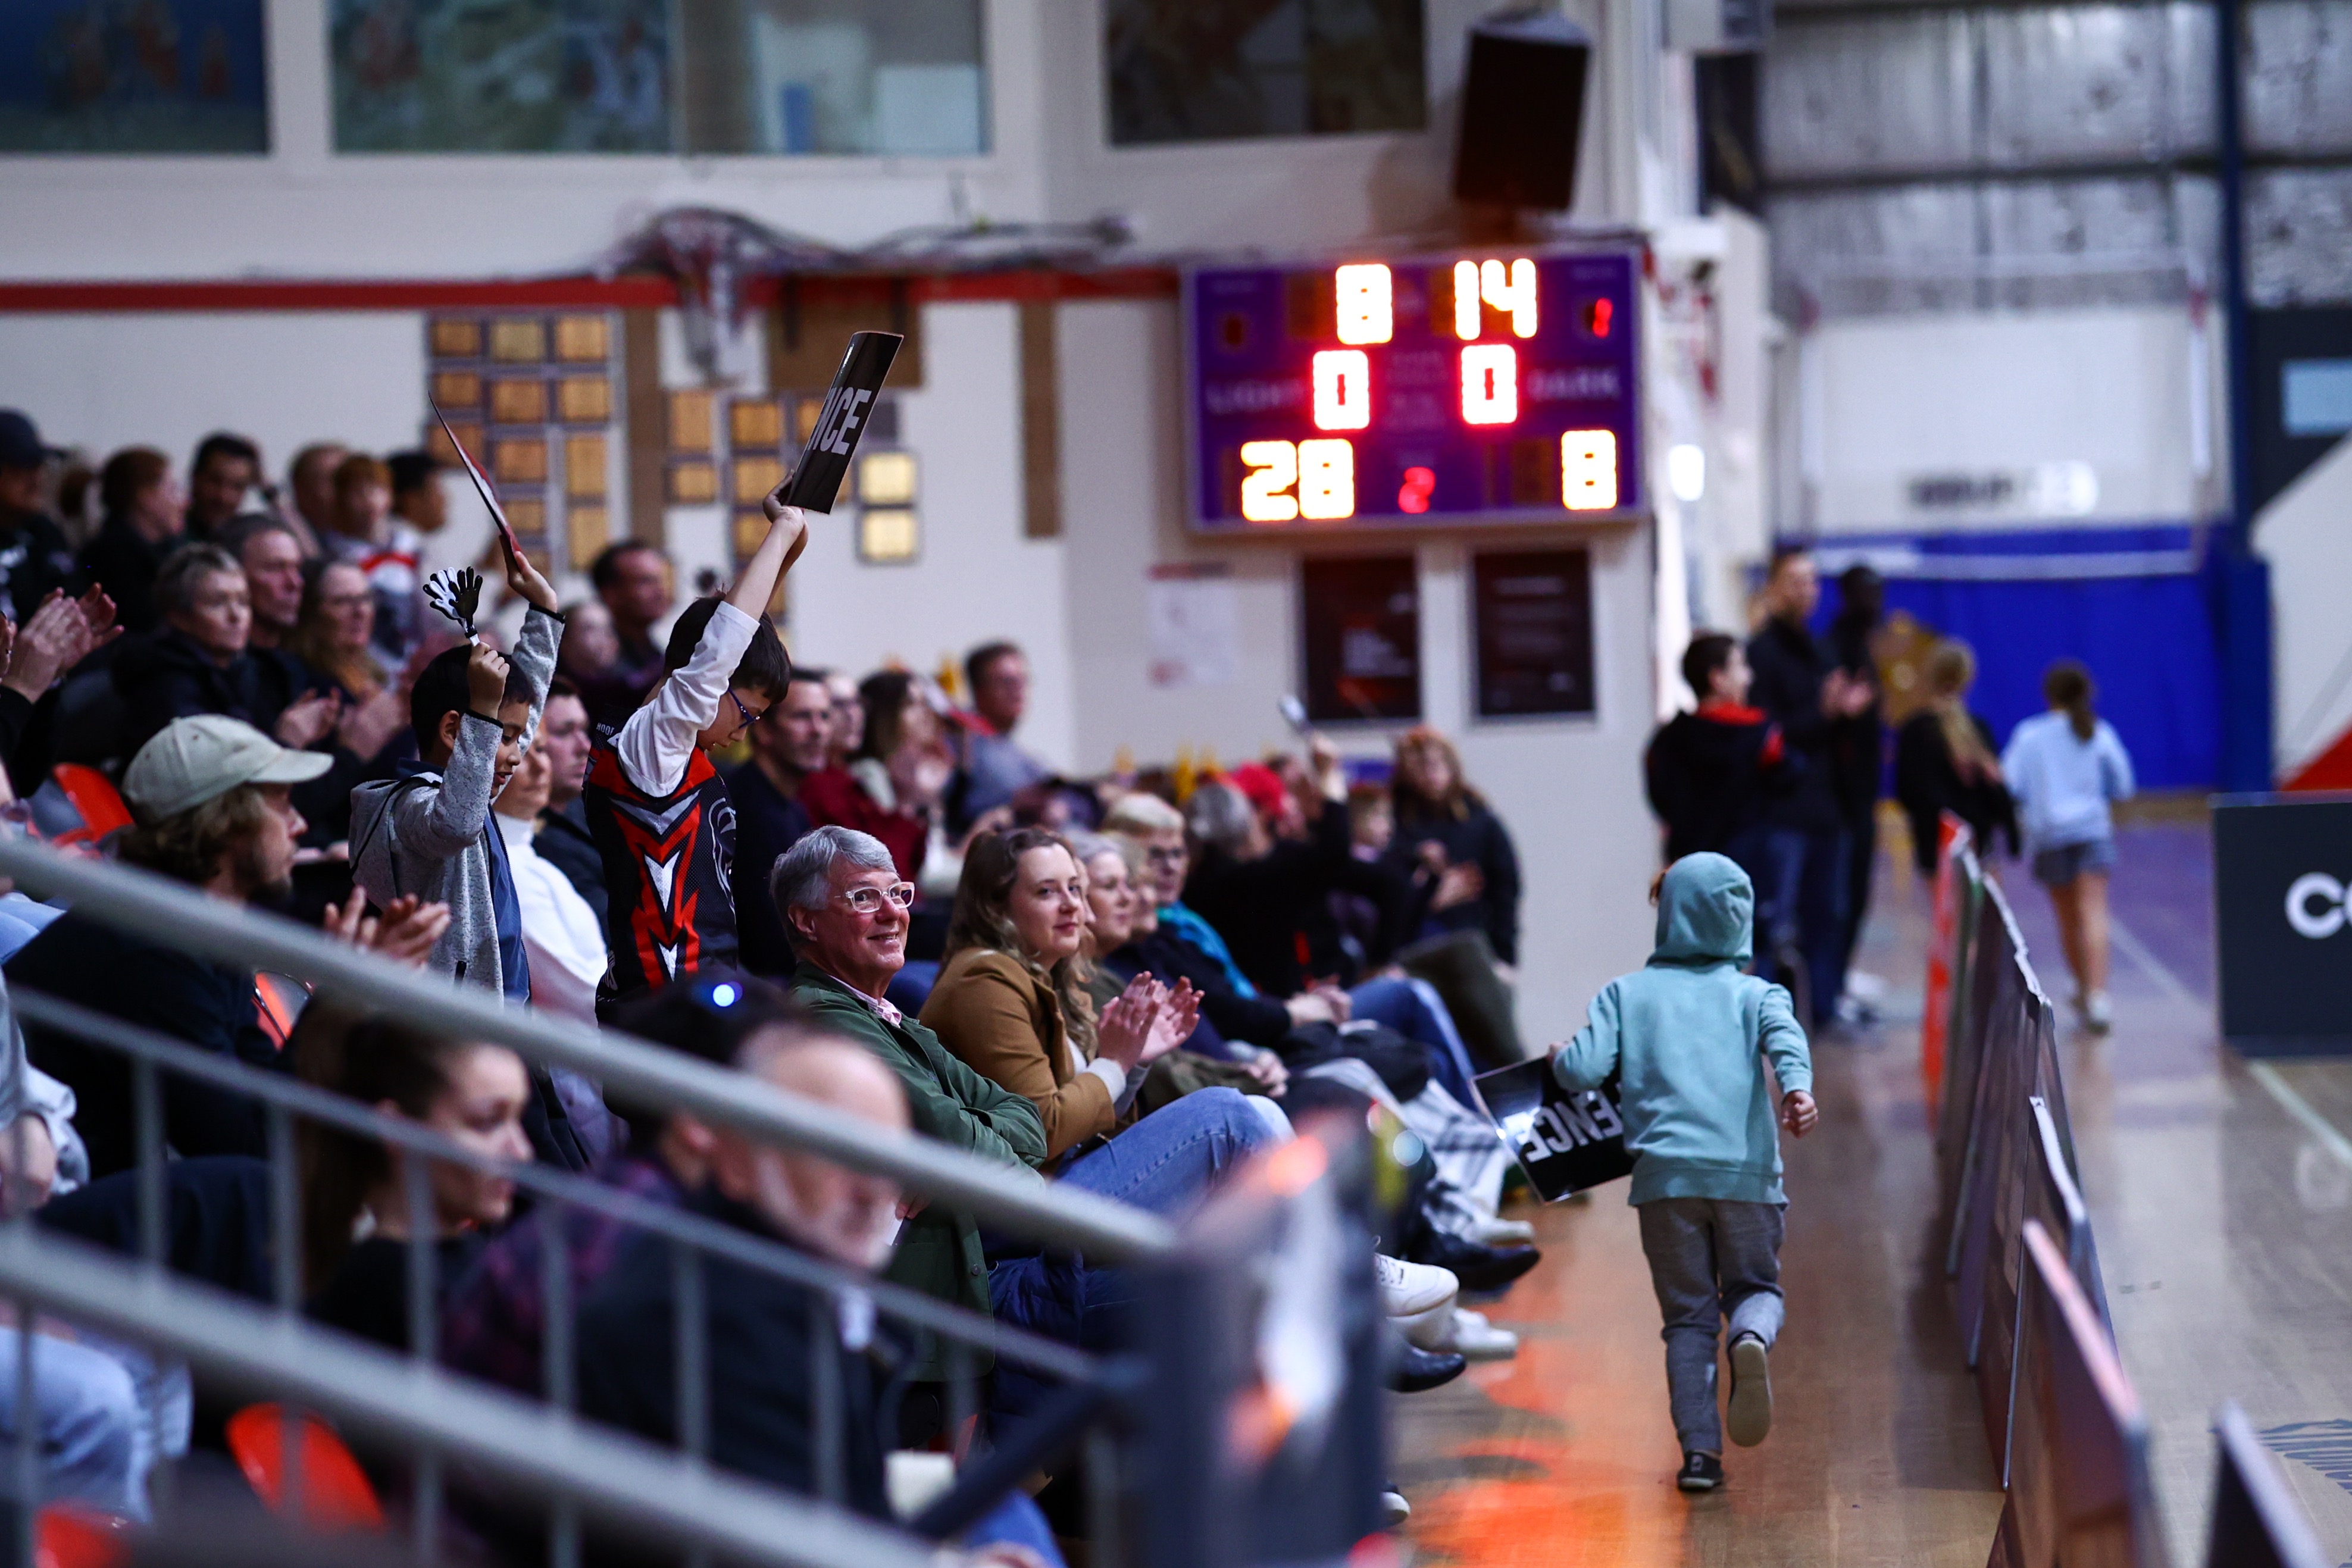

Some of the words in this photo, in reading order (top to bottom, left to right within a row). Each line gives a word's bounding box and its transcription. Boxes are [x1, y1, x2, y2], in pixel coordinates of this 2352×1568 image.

[1335, 263, 1393, 345] 8
[1453, 257, 1538, 341] 14
[807, 386, 873, 456] NCE
[1312, 349, 1371, 431] 0
[1460, 343, 1518, 425] 0
[1241, 438, 1355, 521] 28
[1561, 429, 1617, 511] 8
[2284, 872, 2352, 939] C
[1502, 1090, 1624, 1163] ENCE
